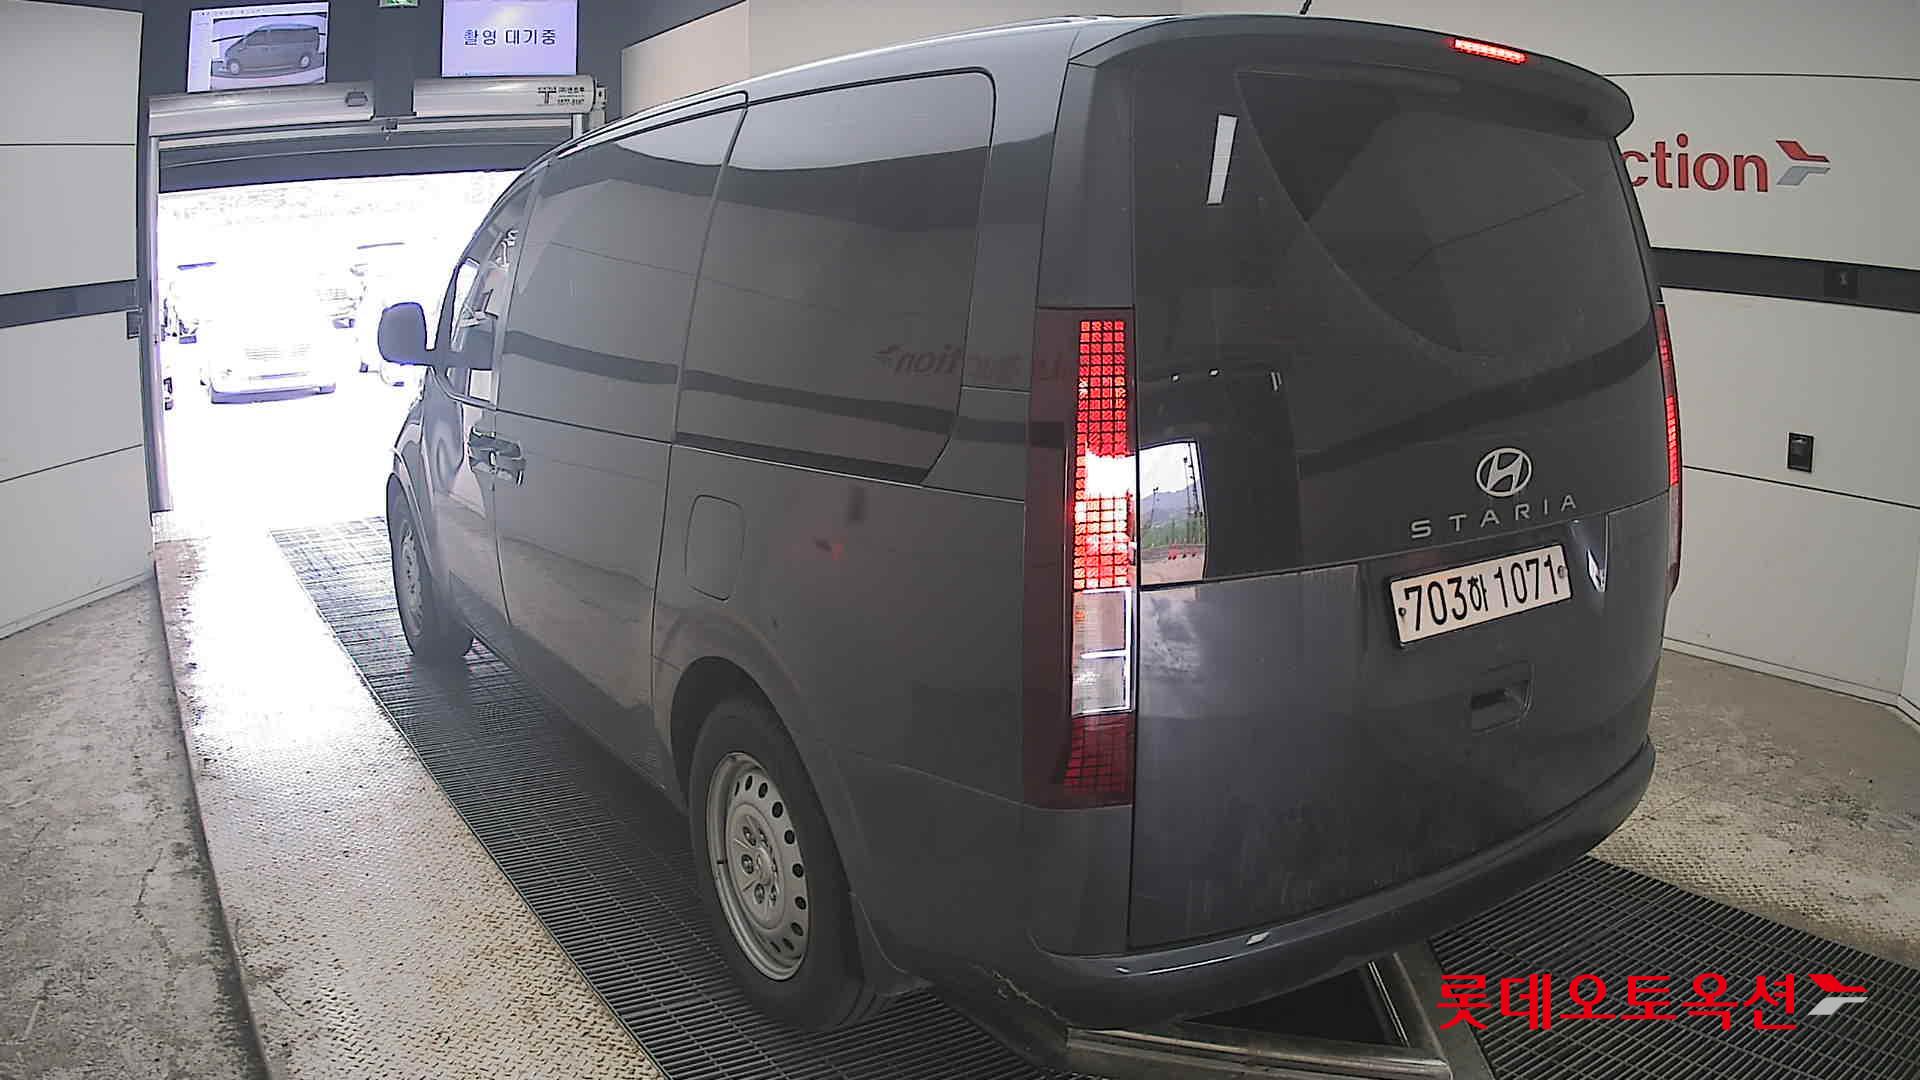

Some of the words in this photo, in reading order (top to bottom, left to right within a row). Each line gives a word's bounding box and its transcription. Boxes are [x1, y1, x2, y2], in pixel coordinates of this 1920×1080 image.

[505, 29, 557, 46] 대기중
[1411, 494, 1577, 539] STARIA
[1404, 573, 1489, 632] 703하
[1494, 553, 1559, 609] 1071
